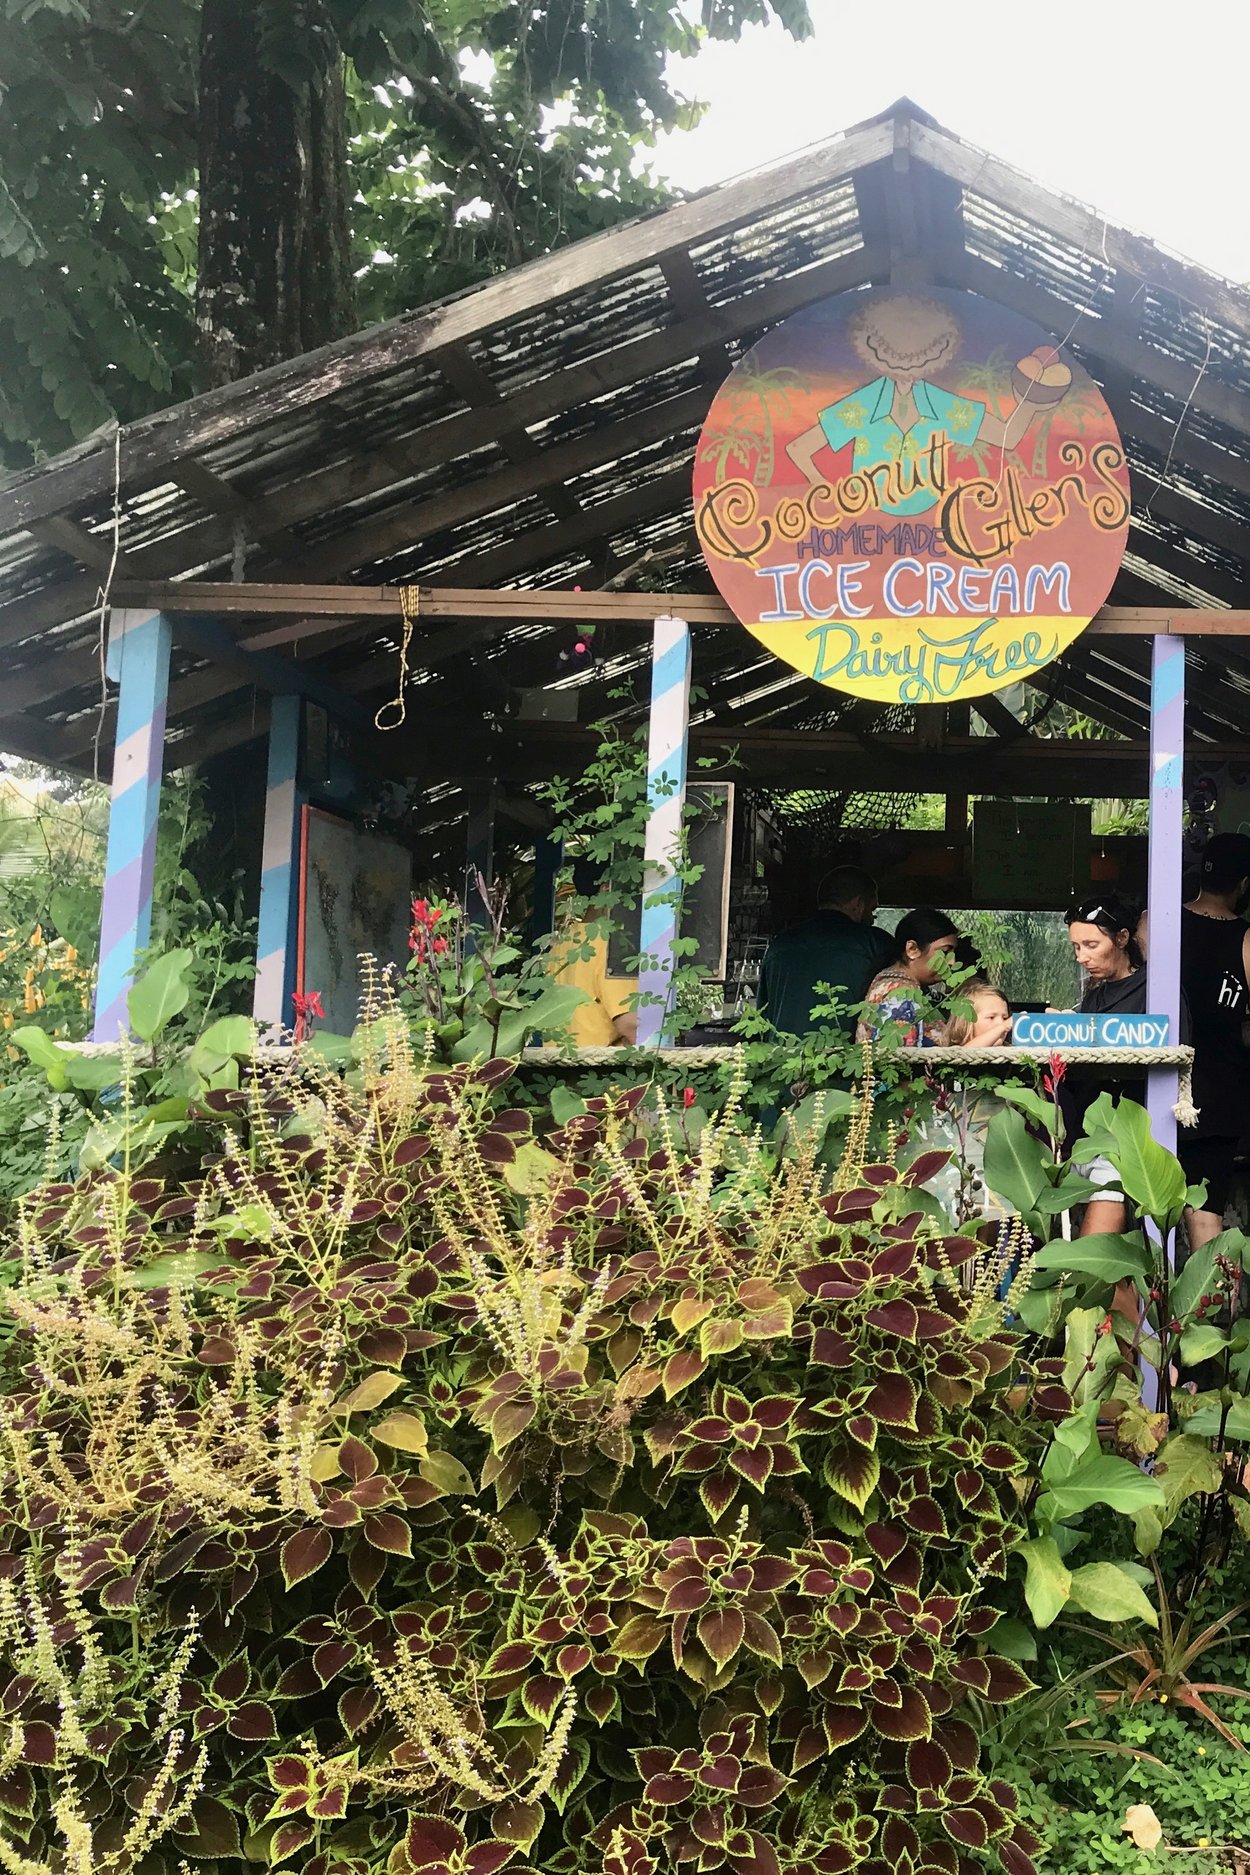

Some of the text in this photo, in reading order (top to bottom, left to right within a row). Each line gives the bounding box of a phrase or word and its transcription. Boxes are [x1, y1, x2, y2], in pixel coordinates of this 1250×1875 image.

[697, 429, 949, 568] Coconut
[797, 523, 947, 559] HOMEMADE
[755, 559, 1072, 622] ICE CREAM
[805, 616, 1059, 703] Dairy Free
[1217, 978, 1242, 1008] hi
[1101, 1017, 1169, 1047] CANDY
